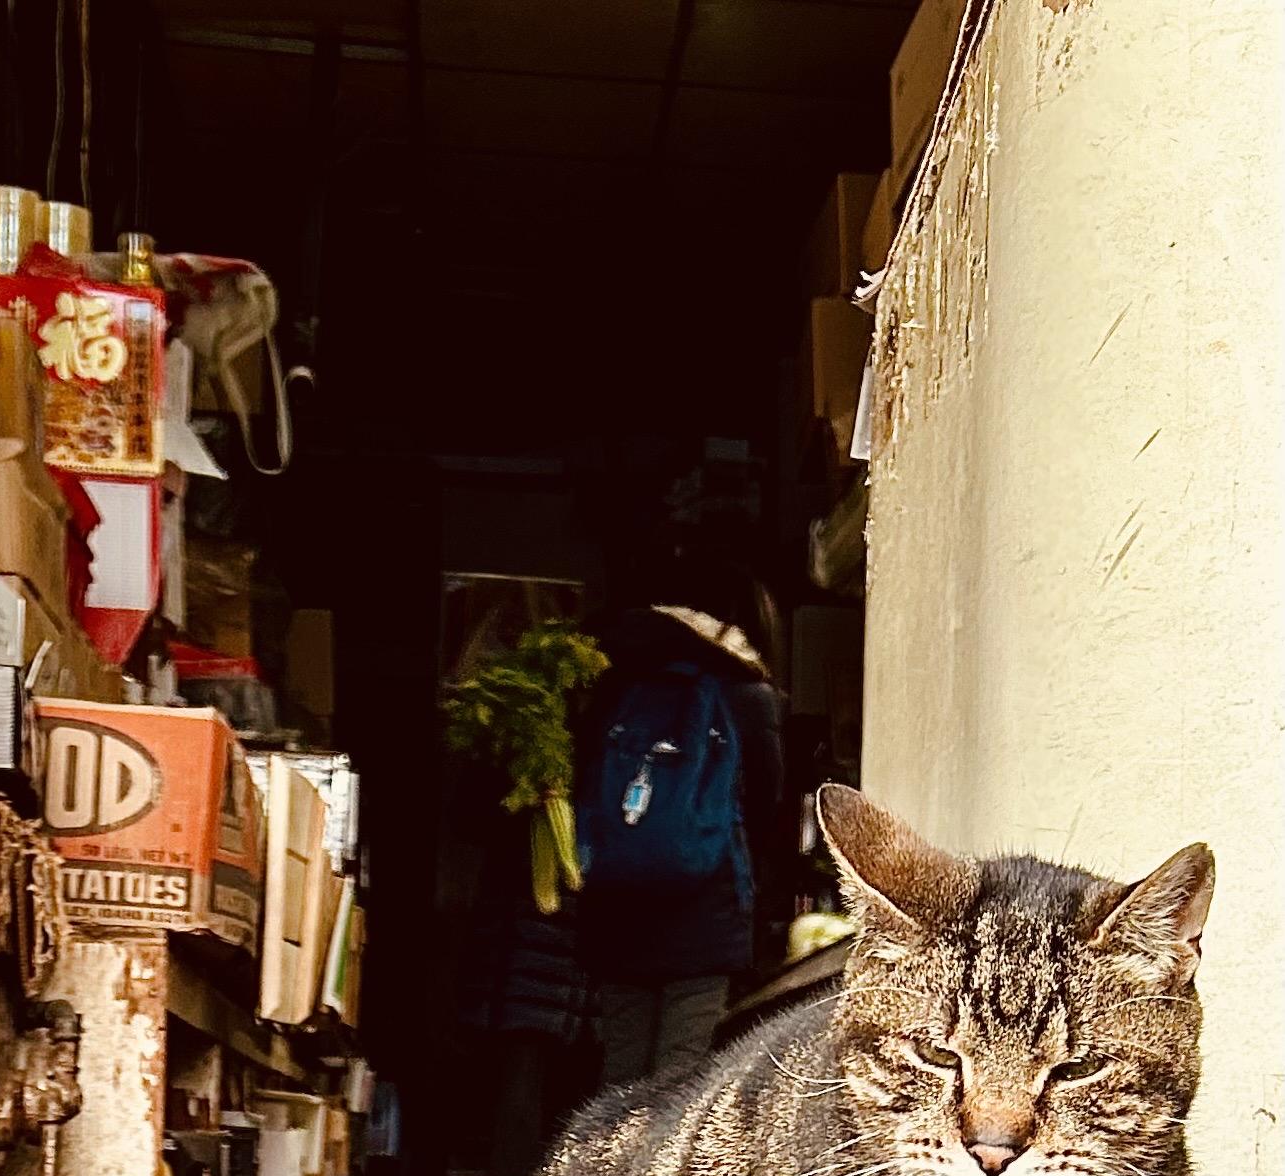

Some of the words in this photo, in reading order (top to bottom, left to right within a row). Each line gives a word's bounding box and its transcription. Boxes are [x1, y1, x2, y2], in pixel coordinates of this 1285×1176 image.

[38, 291, 128, 383] 福
[45, 726, 153, 829] OD
[140, 849, 165, 862] NET
[62, 867, 188, 908] TATOES
[98, 908, 143, 921] IDAHO
